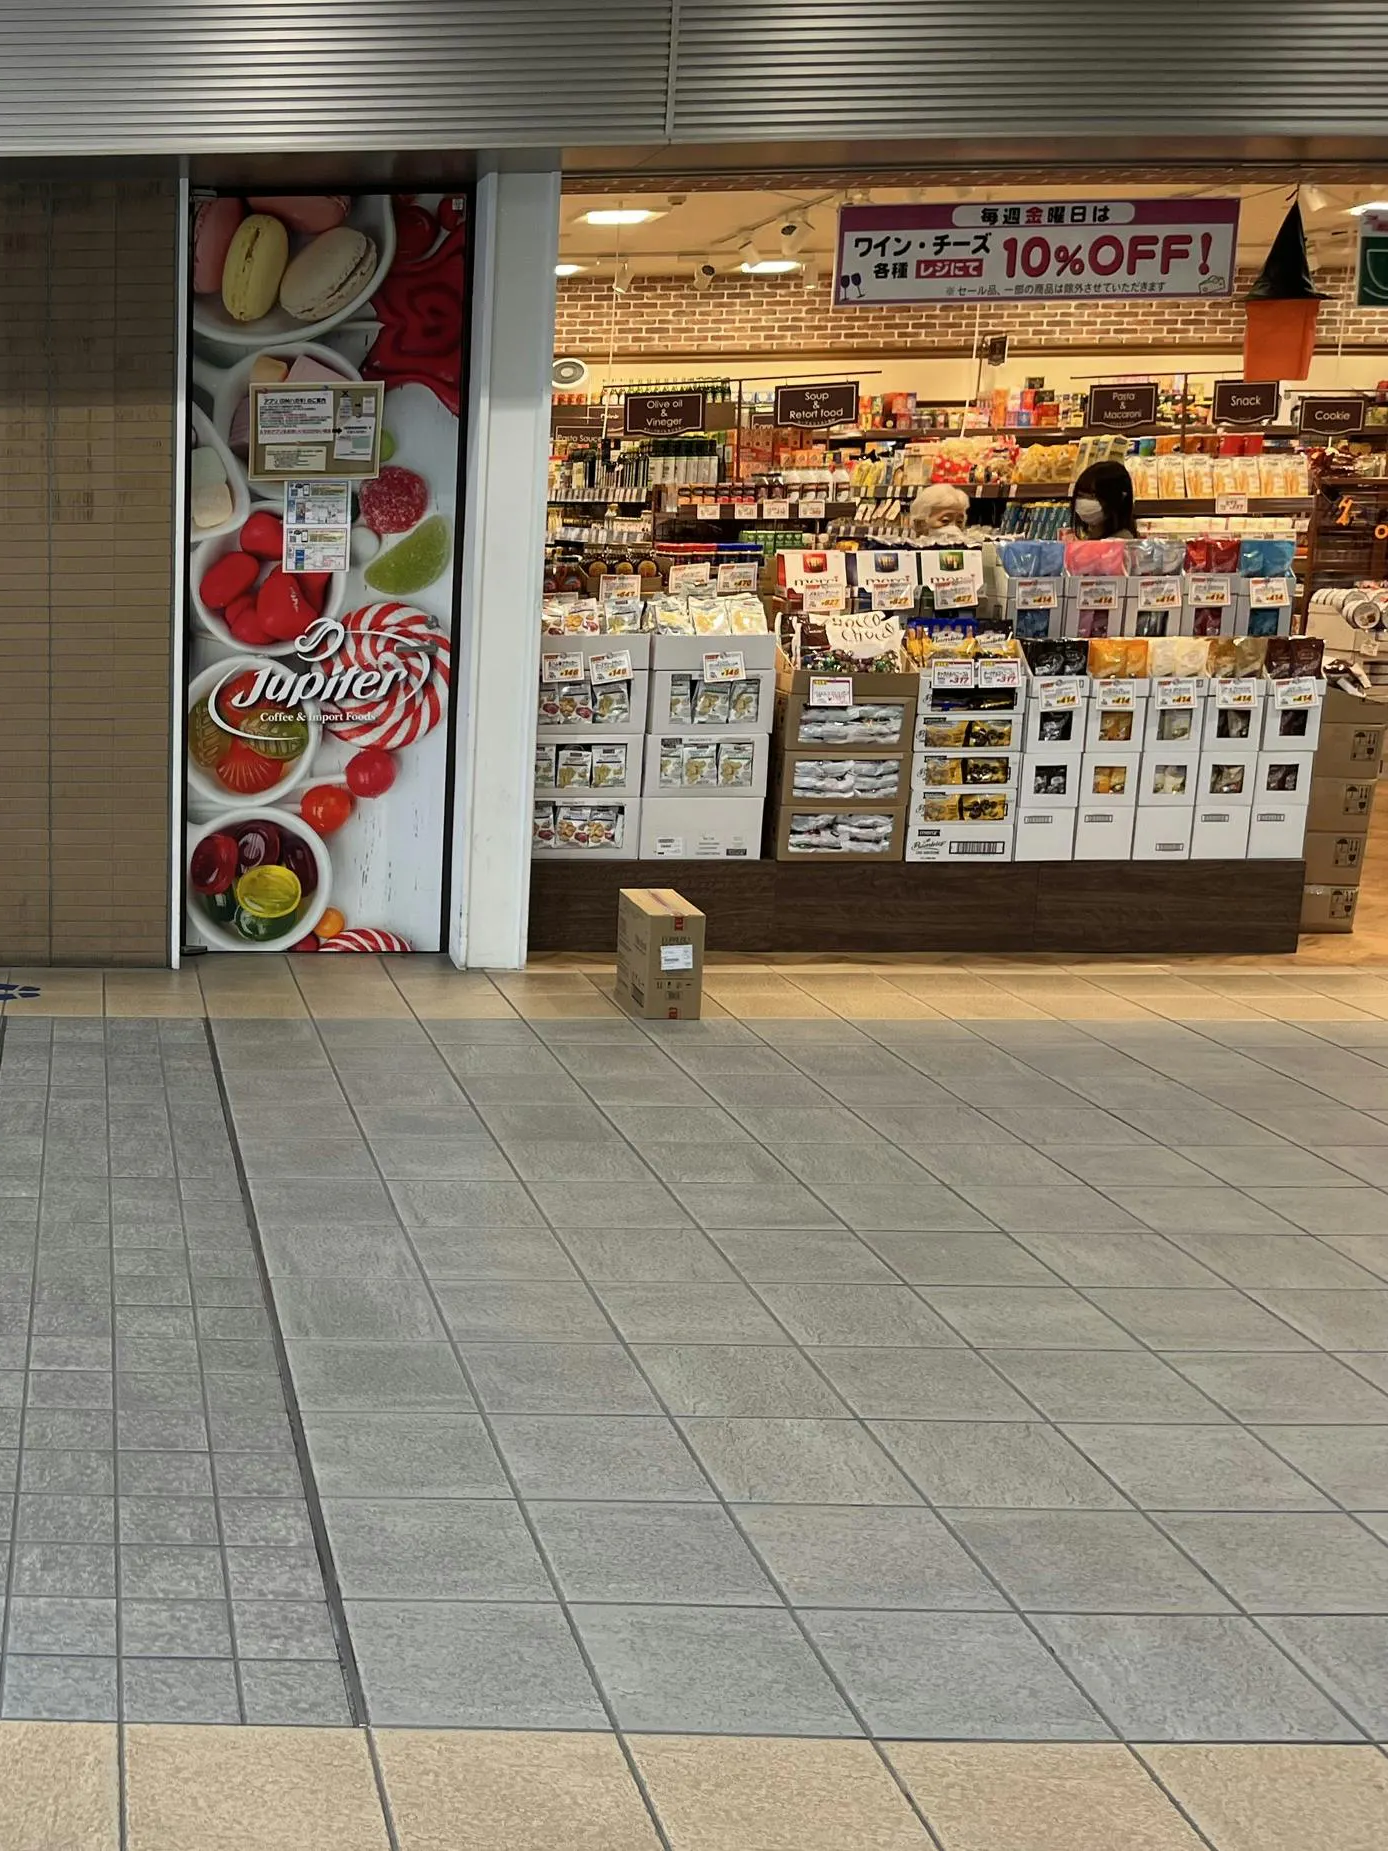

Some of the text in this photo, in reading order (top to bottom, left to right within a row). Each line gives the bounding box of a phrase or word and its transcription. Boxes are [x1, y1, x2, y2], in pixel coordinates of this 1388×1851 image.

[980, 205, 1110, 226] 毎週金曜日は
[854, 232, 991, 258] ワイン・チーズ
[873, 261, 982, 279] 各種 レジにて
[804, 391, 829, 401] Soup
[1112, 391, 1135, 401] Pasta
[1230, 395, 1261, 407] Snack
[646, 399, 683, 410] Olive oil
[812, 400, 820, 409] &
[1119, 402, 1126, 410] &
[660, 408, 668, 417] &
[789, 408, 844, 419] Retort food
[1103, 409, 1142, 420] Macaroni
[1314, 410, 1351, 421] Cookie
[646, 417, 683, 428] Vinegar
[231, 662, 410, 708] Jupiter
[260, 710, 377, 725] Coffee & Import Foods
